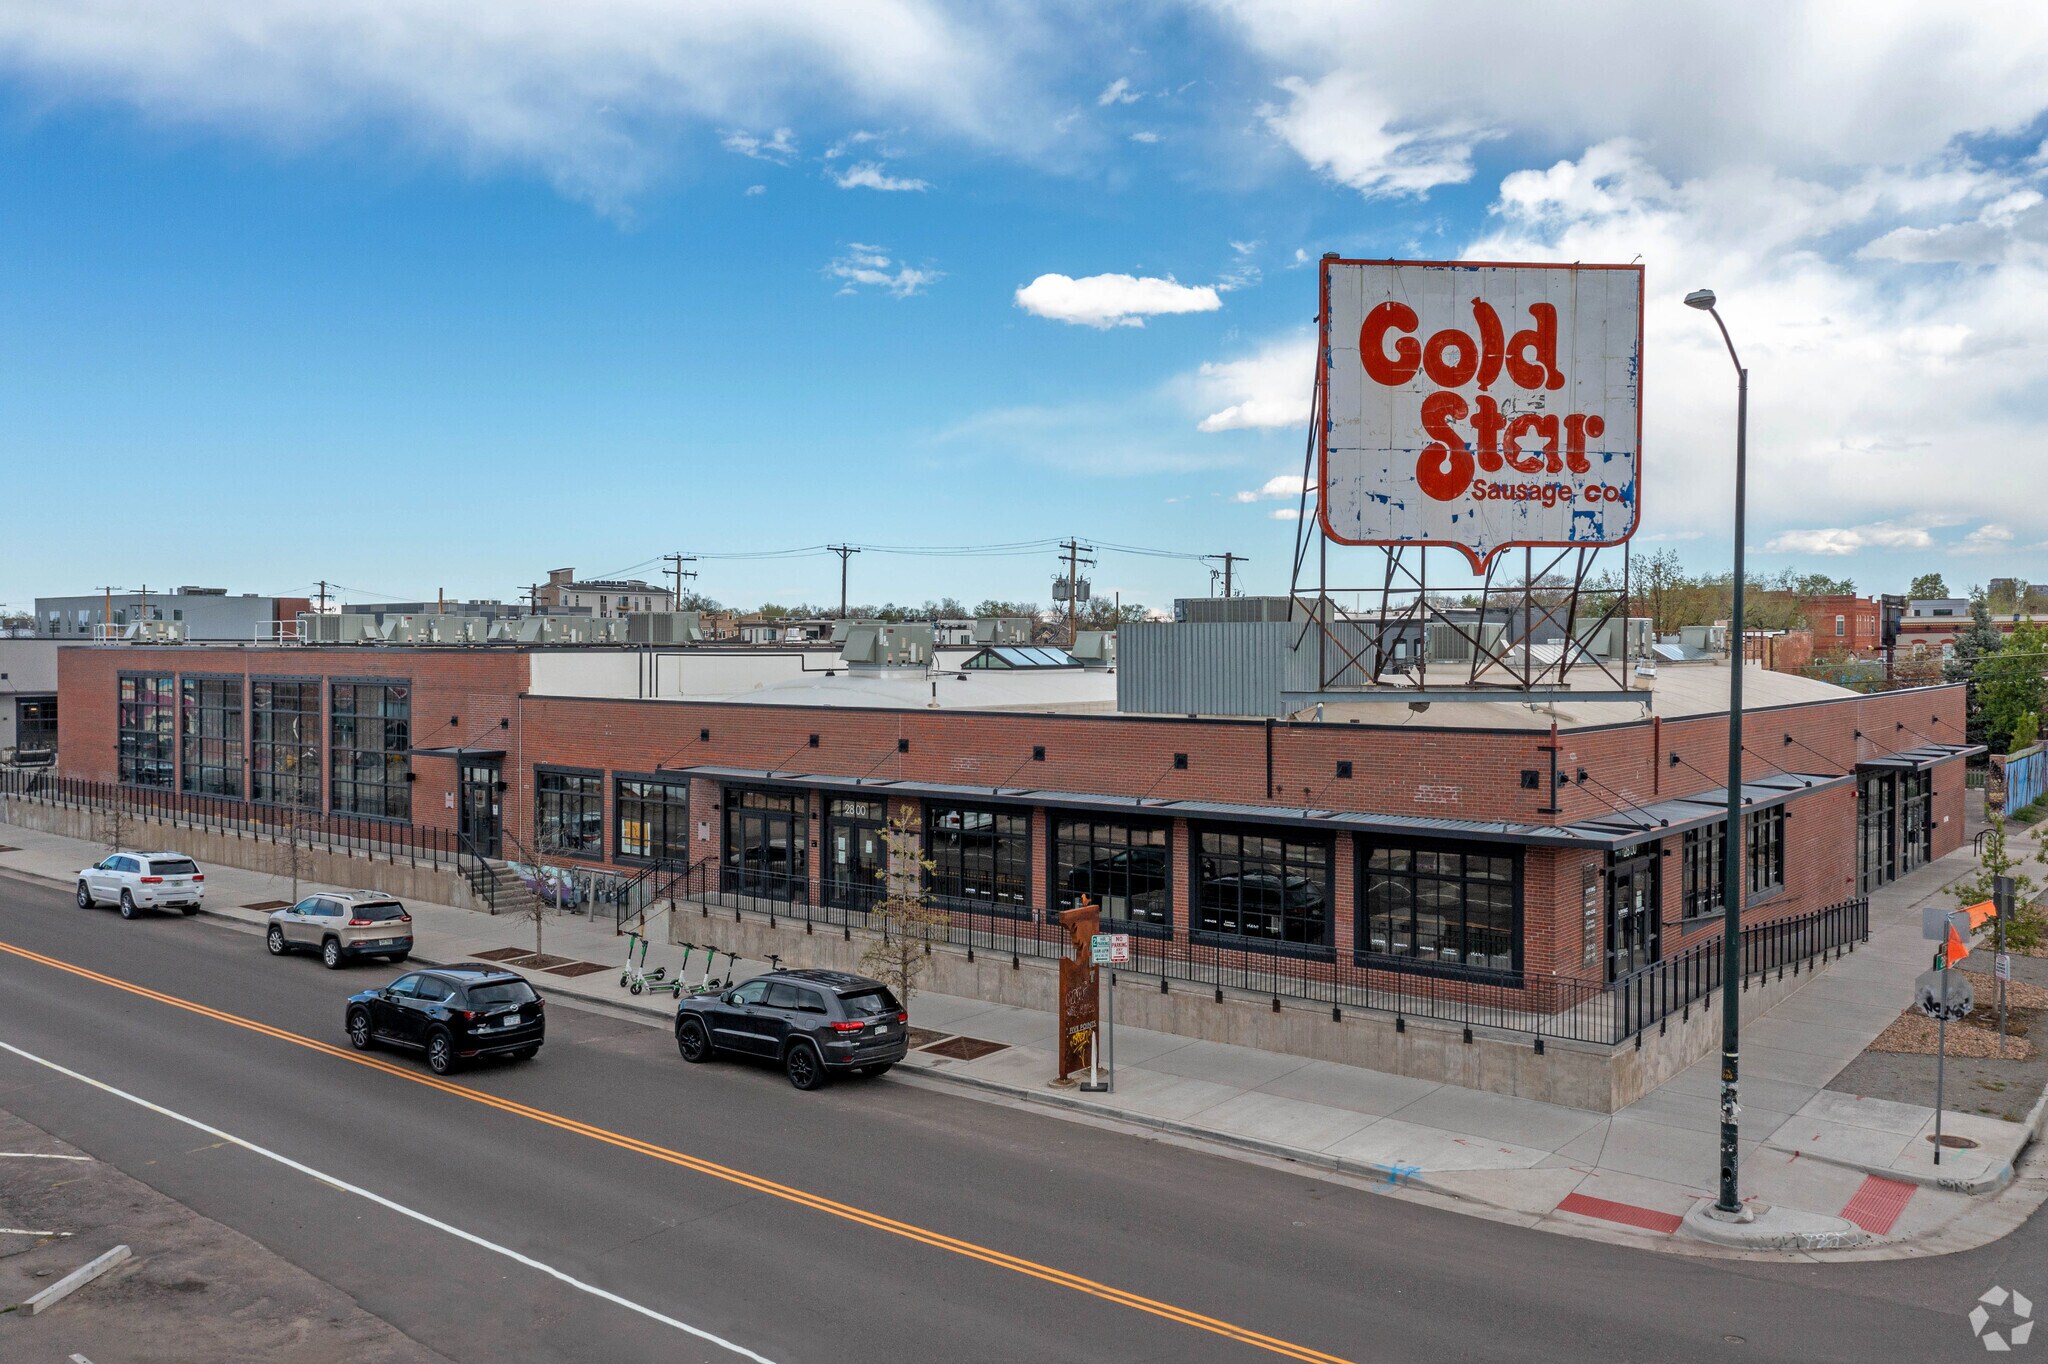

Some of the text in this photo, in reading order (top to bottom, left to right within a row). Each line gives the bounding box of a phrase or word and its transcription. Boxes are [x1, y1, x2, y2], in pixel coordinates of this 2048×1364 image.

[1359, 296, 1565, 391] Gold
[1416, 391, 1605, 502] Star
[1471, 479, 1572, 508] Sausage
[845, 804, 866, 816] 2800
[1069, 1025, 1080, 1034] FIVE
